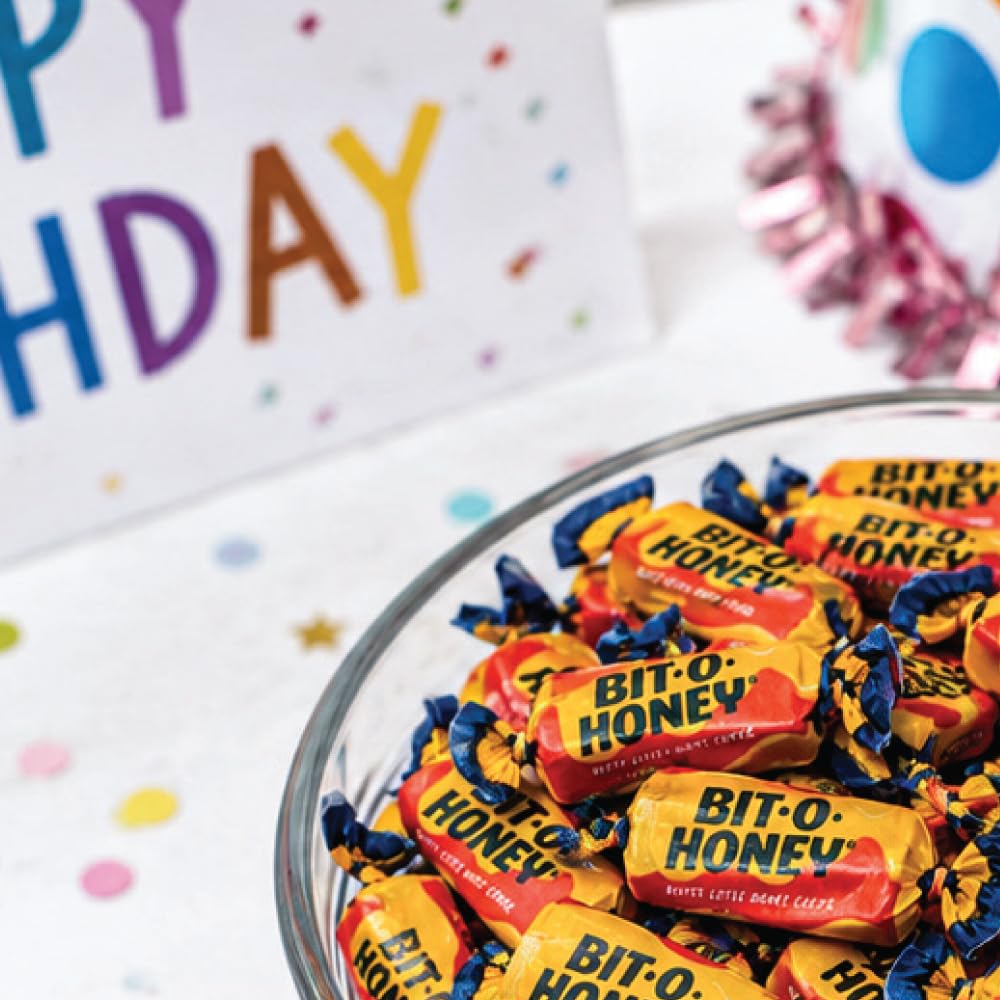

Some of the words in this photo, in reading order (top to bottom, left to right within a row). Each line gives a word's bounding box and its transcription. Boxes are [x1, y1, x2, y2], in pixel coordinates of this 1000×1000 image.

[647, 534, 788, 595] HONEY
[579, 678, 748, 757] HONEY
[422, 789, 557, 884] HONEY
[665, 826, 848, 877] HONEY
